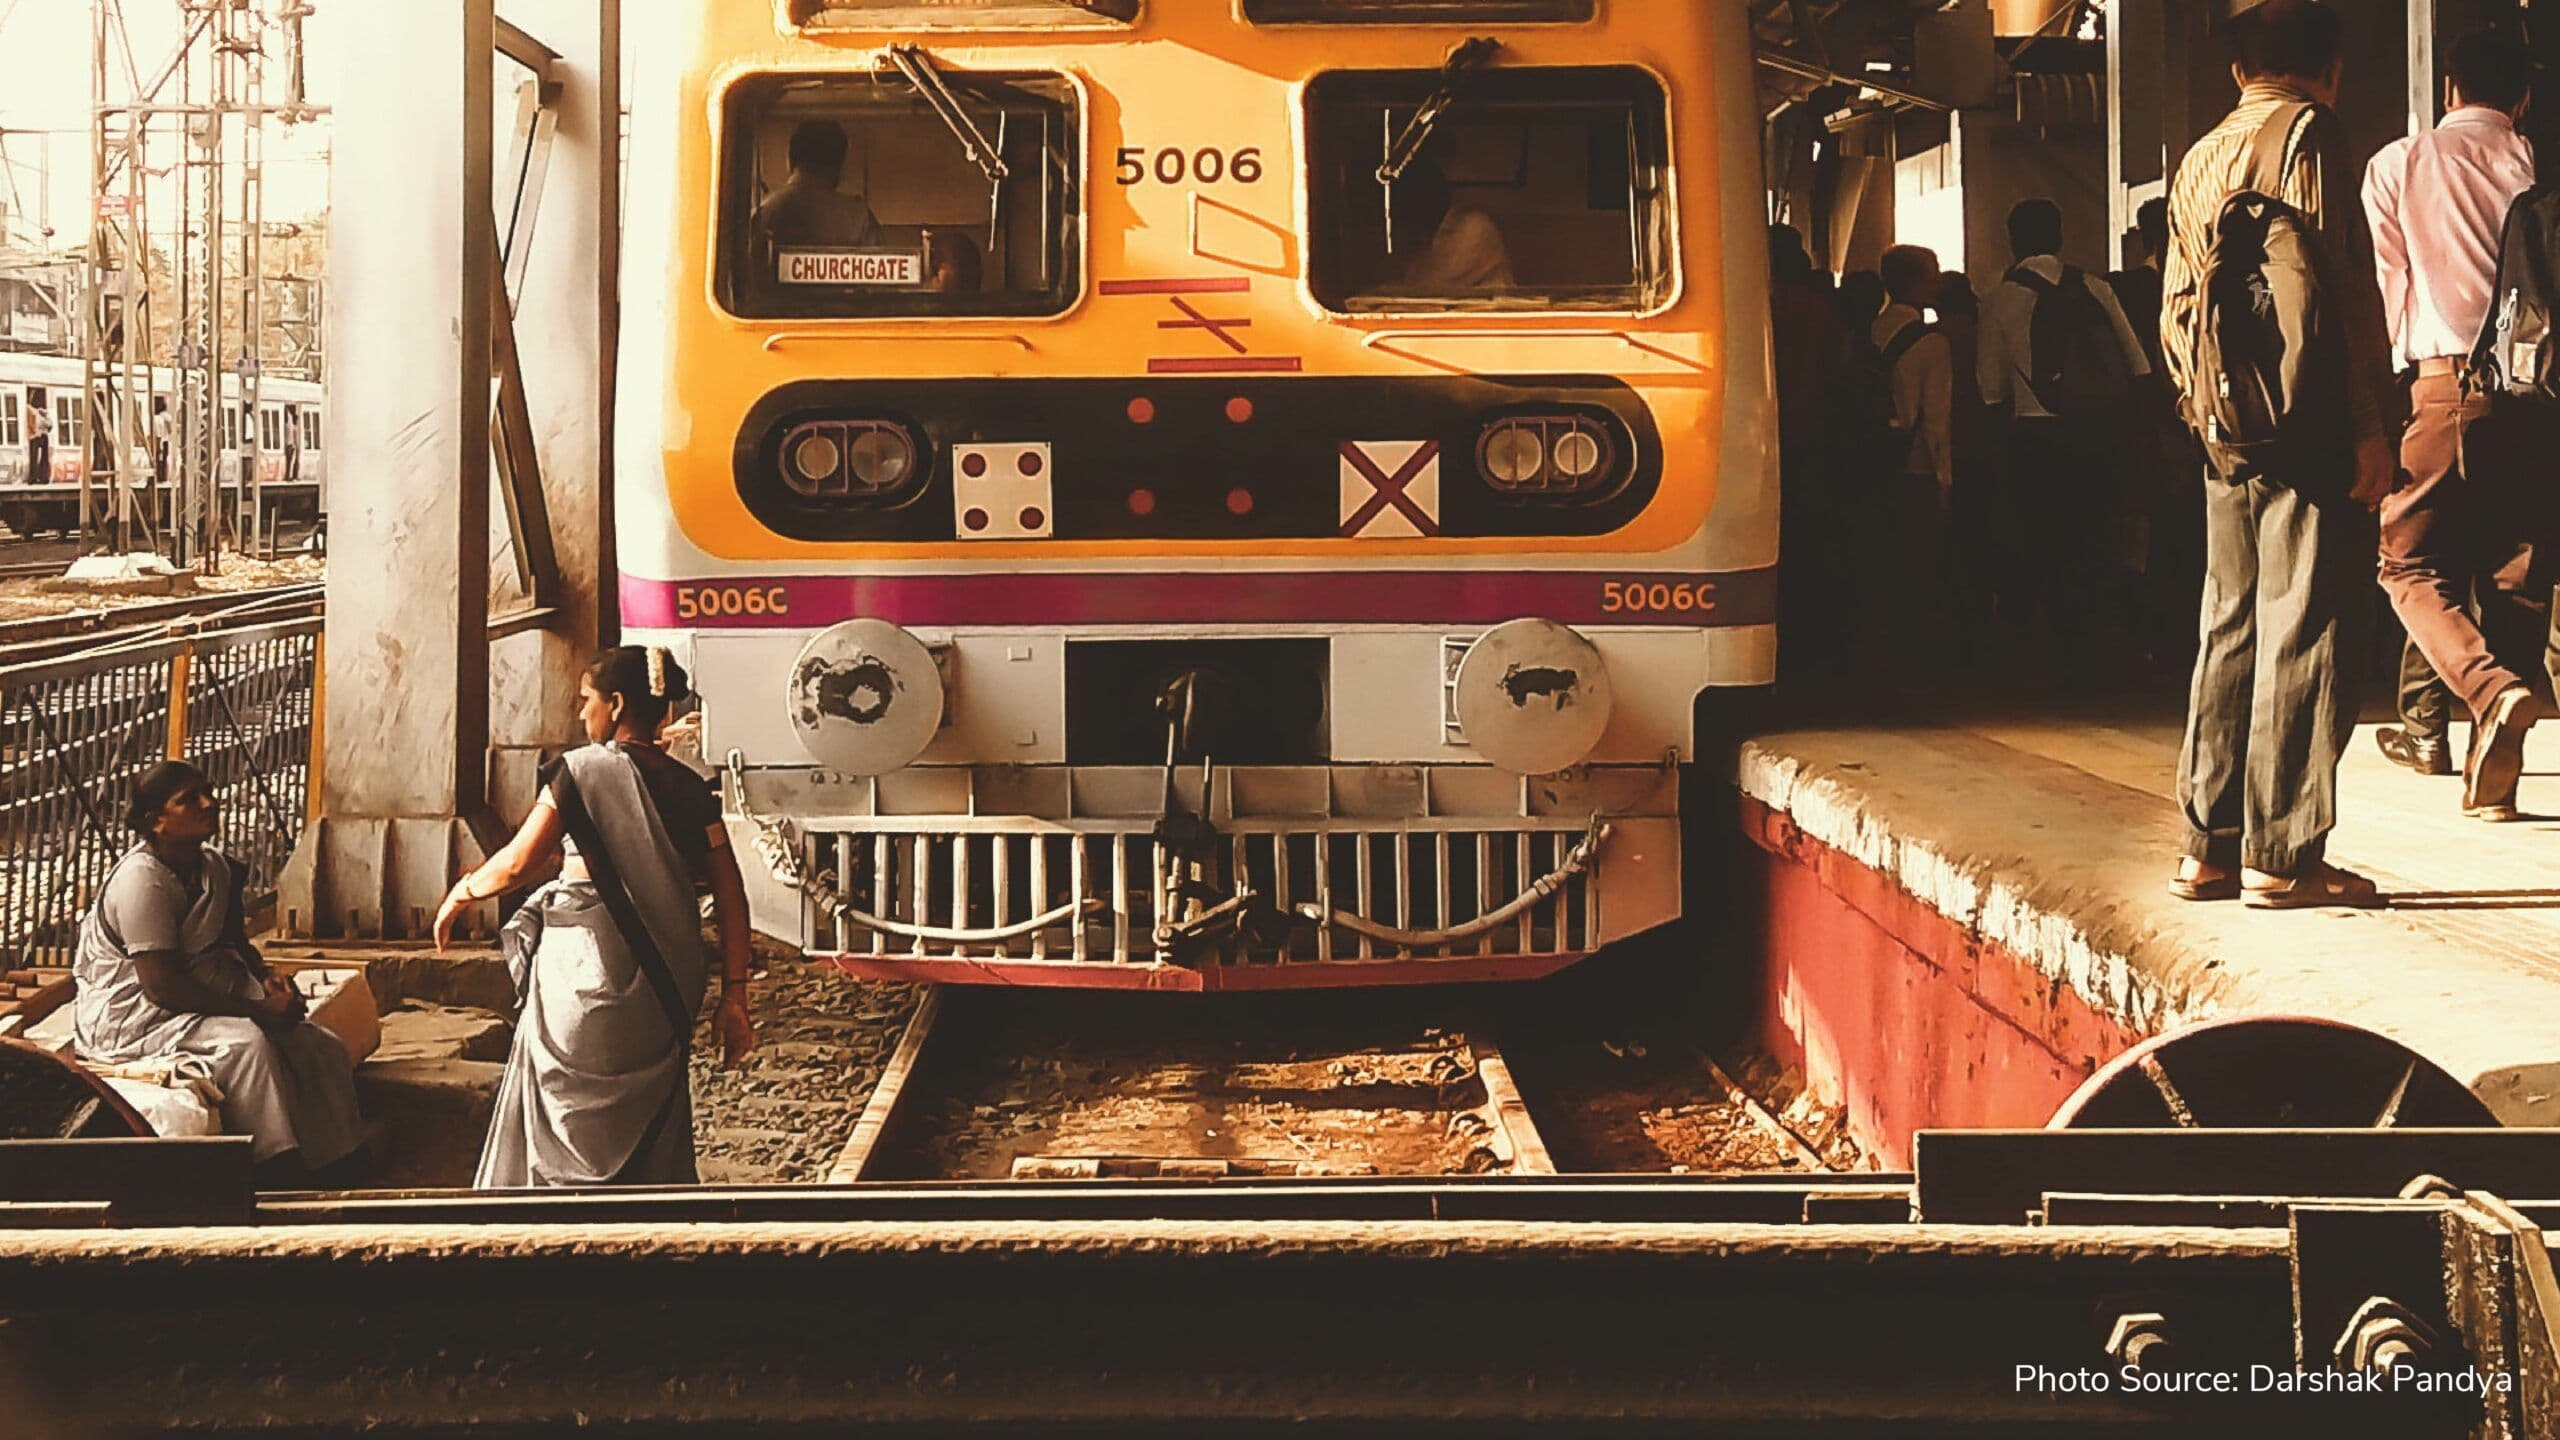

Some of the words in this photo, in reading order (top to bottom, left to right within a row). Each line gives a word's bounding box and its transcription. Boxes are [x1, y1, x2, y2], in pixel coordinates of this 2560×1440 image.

[1116, 147, 1262, 185] 5006
[791, 256, 909, 281] CHURCHGATE
[678, 587, 788, 618] 5006C
[1602, 582, 1716, 612] 5006C
